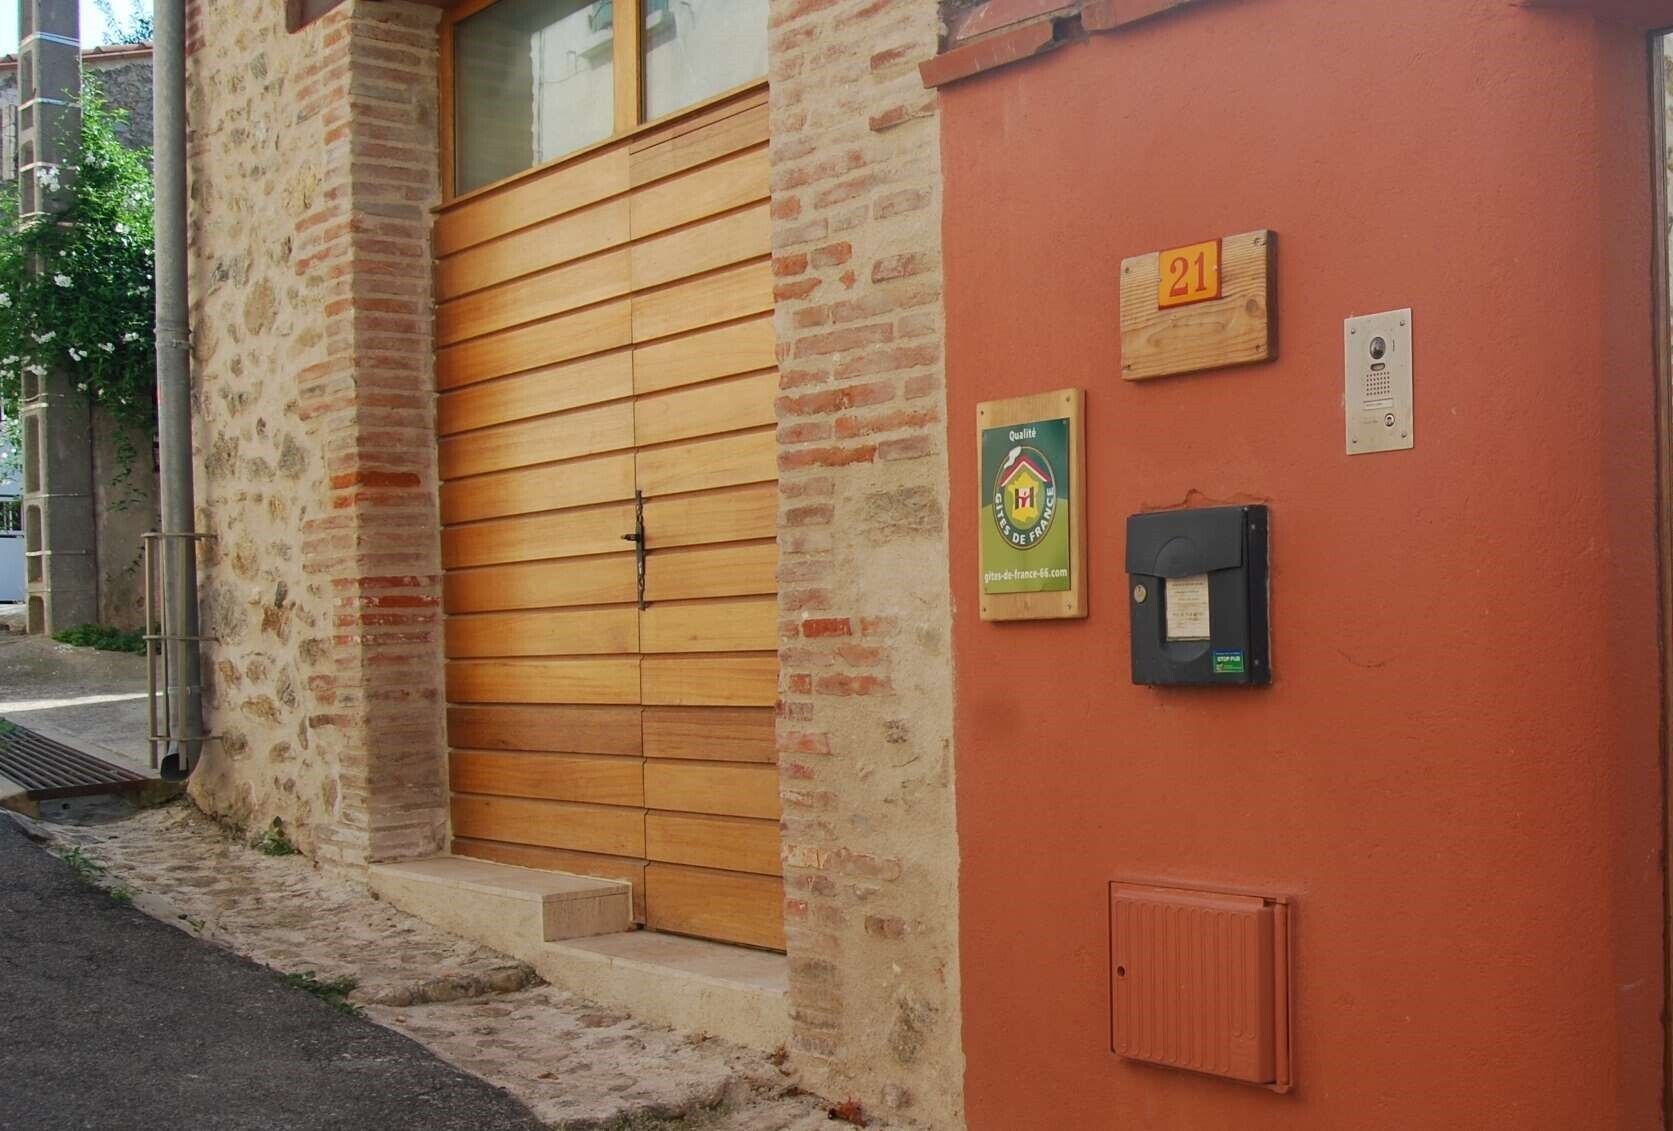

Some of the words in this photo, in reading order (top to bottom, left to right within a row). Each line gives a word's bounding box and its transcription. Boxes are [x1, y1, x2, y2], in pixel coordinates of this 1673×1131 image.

[1169, 251, 1207, 298] 21
[1009, 428, 1036, 442] Qualité
[1012, 532, 1026, 545] DE
[1029, 487, 1054, 542] FRANCE
